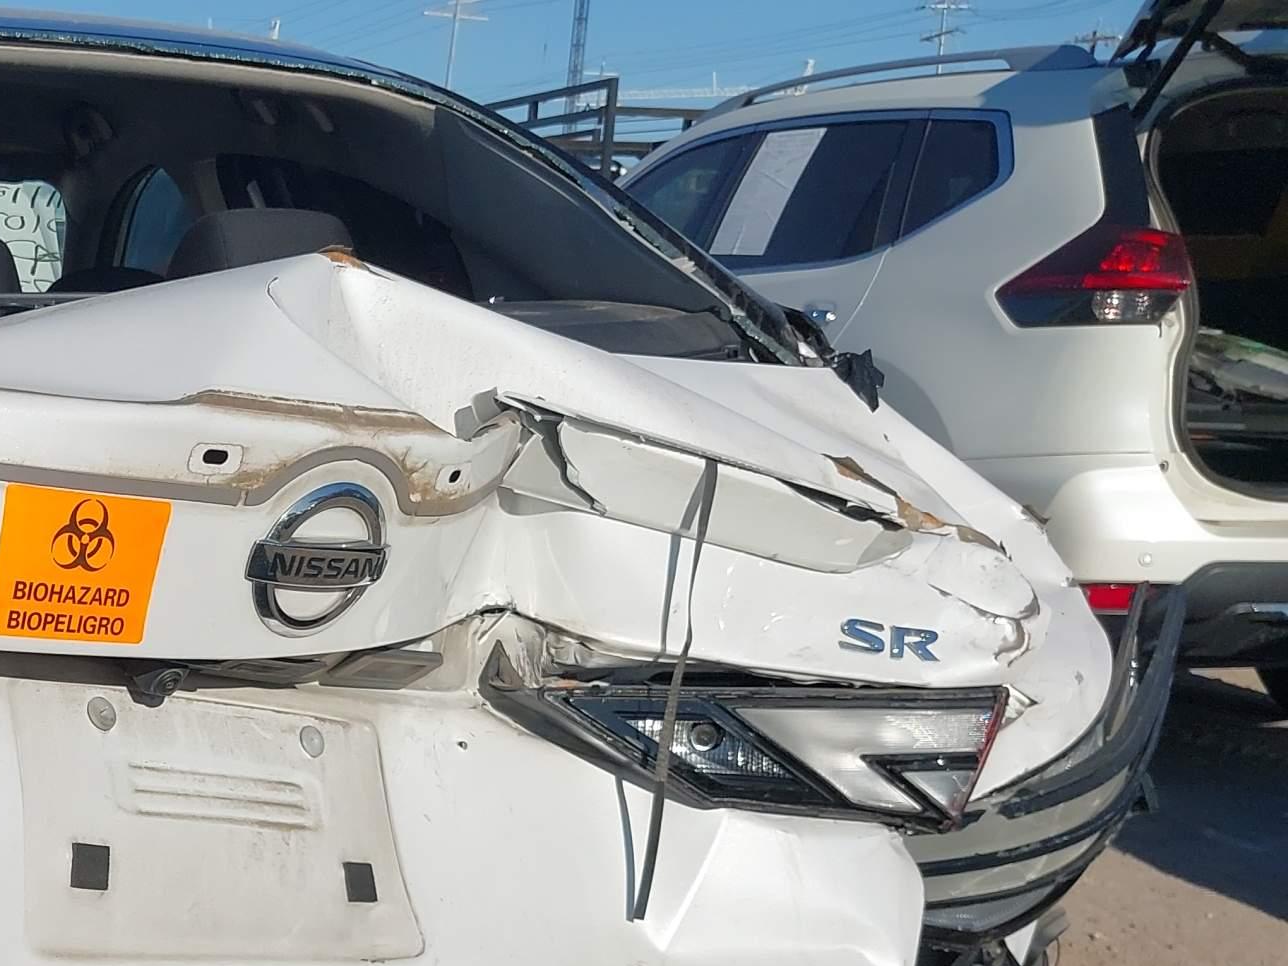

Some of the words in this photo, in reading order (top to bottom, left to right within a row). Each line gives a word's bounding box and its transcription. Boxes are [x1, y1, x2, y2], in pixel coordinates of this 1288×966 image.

[268, 551, 387, 581] NISSAN
[12, 580, 130, 608] BIOHAZARD
[6, 610, 125, 637] BIOPELIGRO
[838, 618, 941, 662] SR
